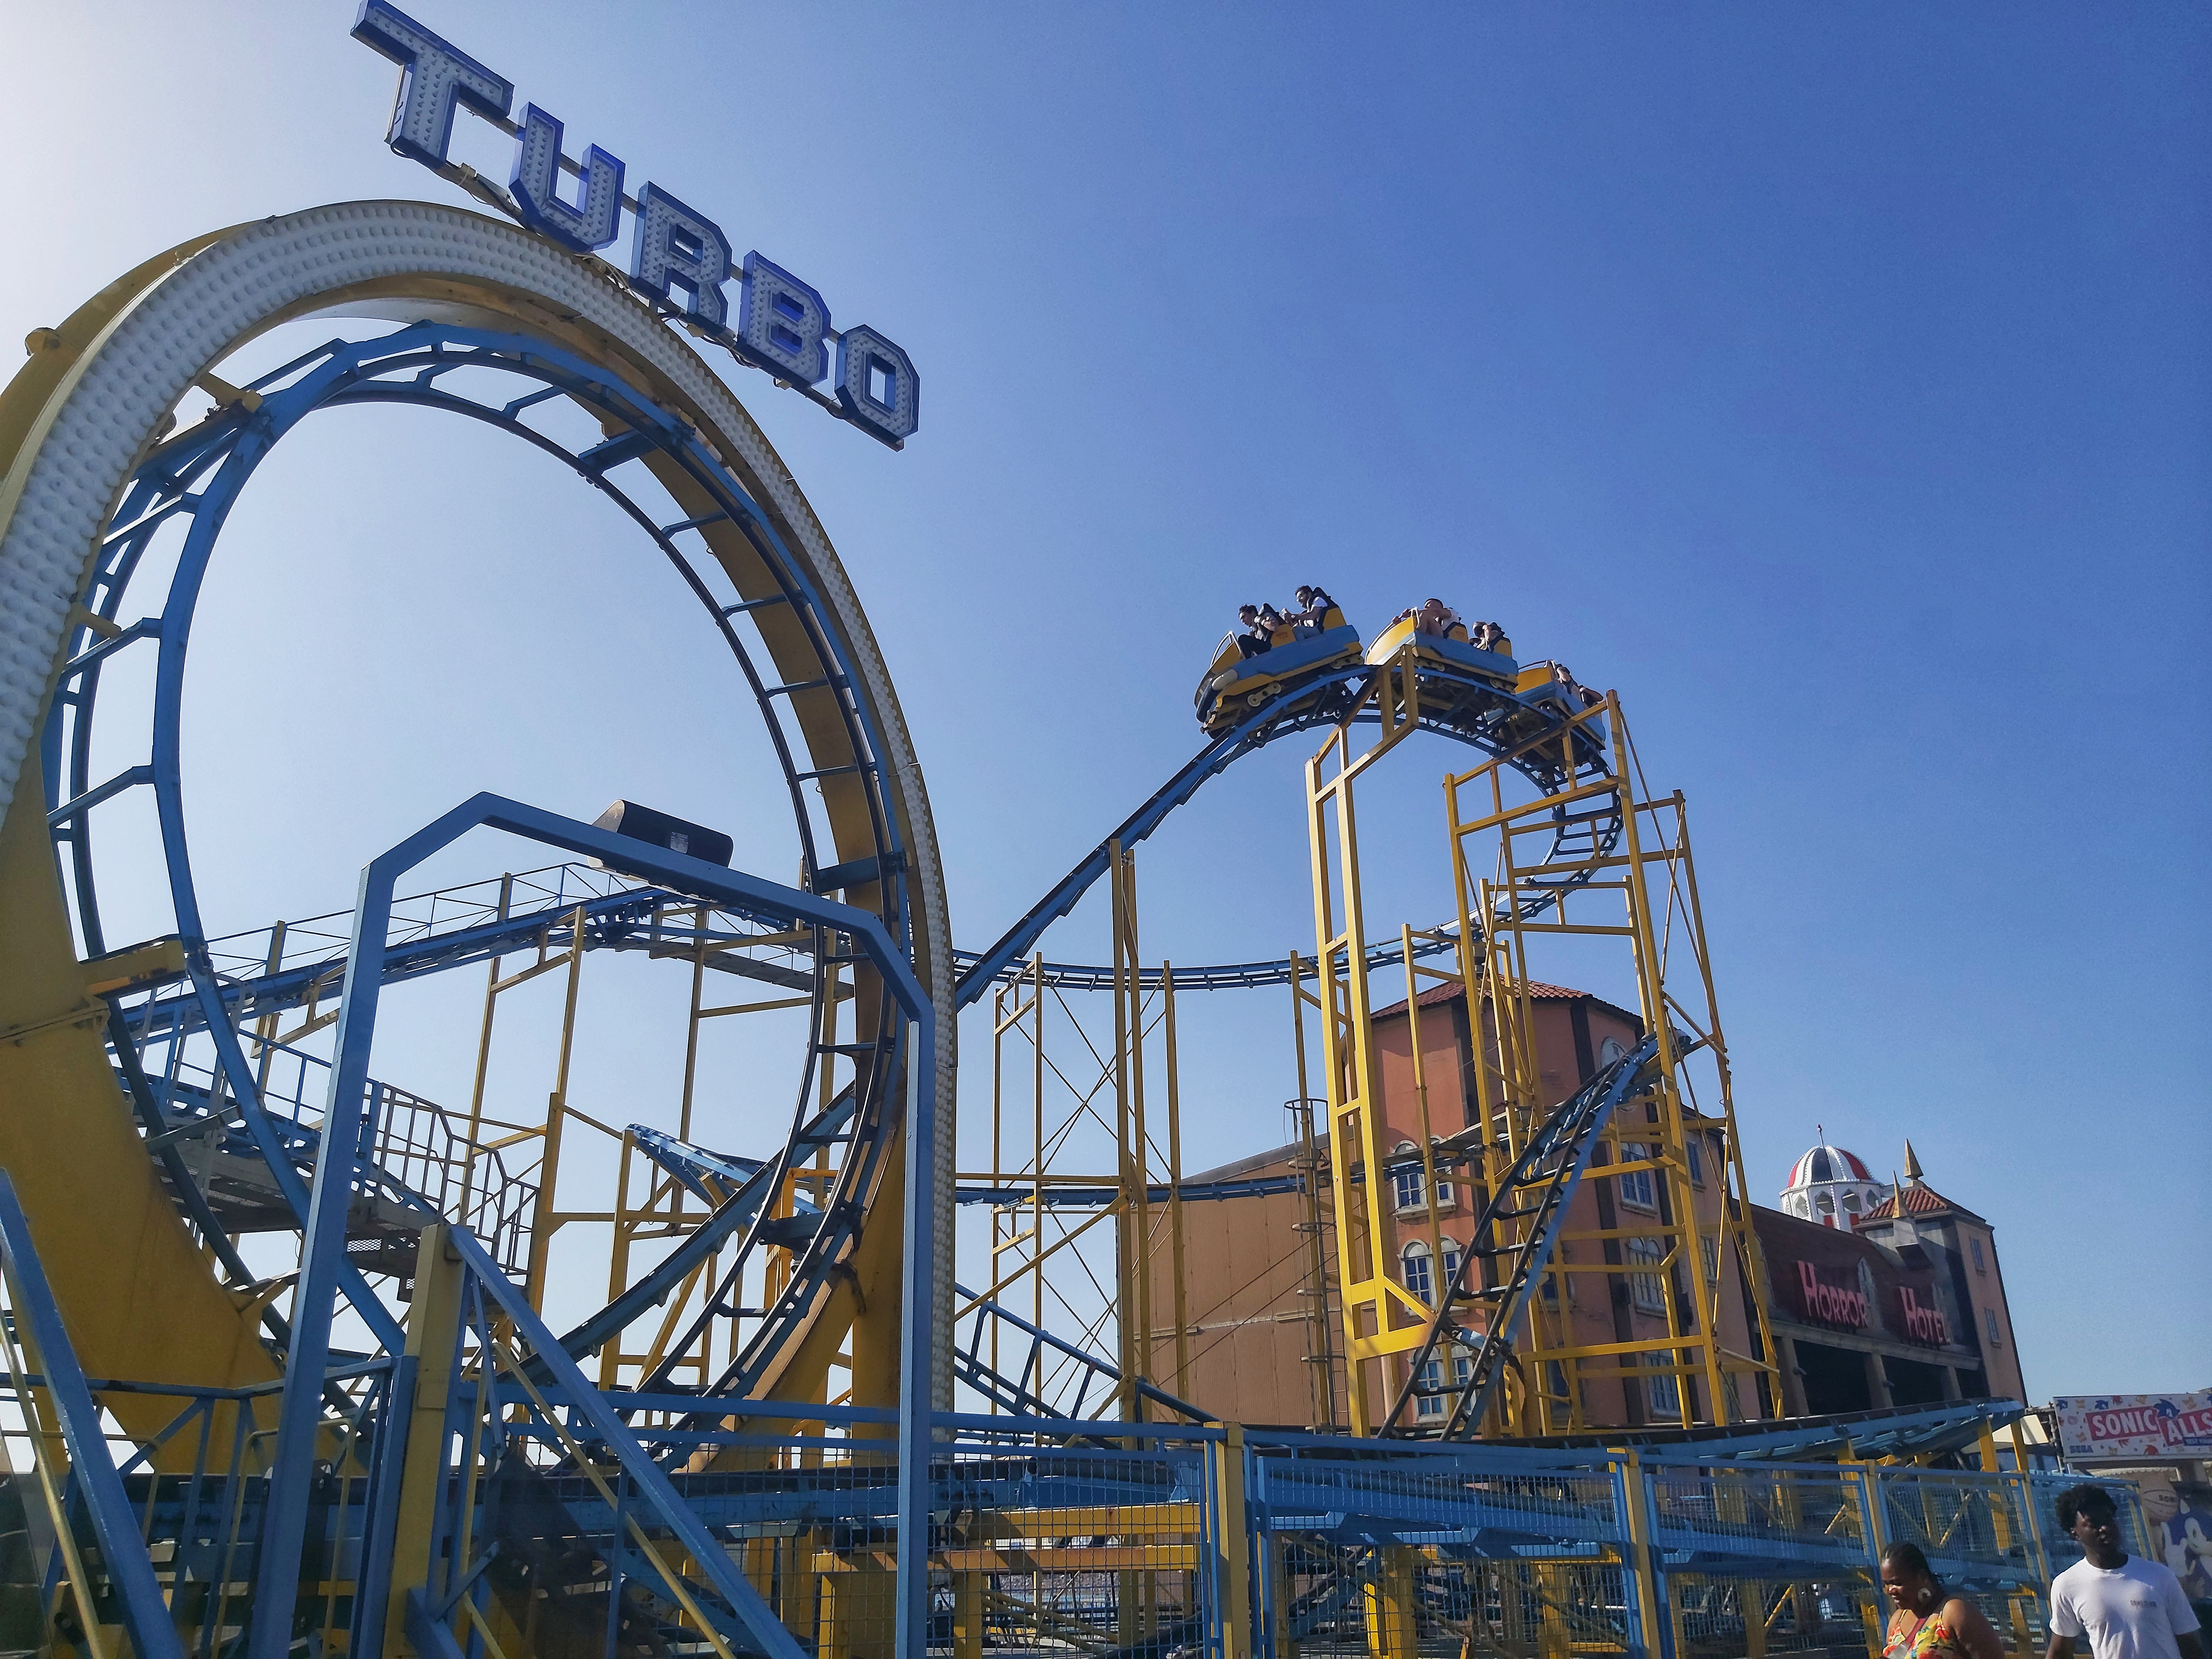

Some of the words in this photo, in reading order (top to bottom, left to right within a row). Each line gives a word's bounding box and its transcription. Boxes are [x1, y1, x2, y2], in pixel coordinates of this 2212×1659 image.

[351, 0, 920, 439] TURBO
[1797, 1260, 1869, 1328] HORROR
[1899, 1286, 1951, 1345] HOTEL
[2069, 1445, 2094, 1454] SEGA
[2092, 1410, 2158, 1437] SONIC
